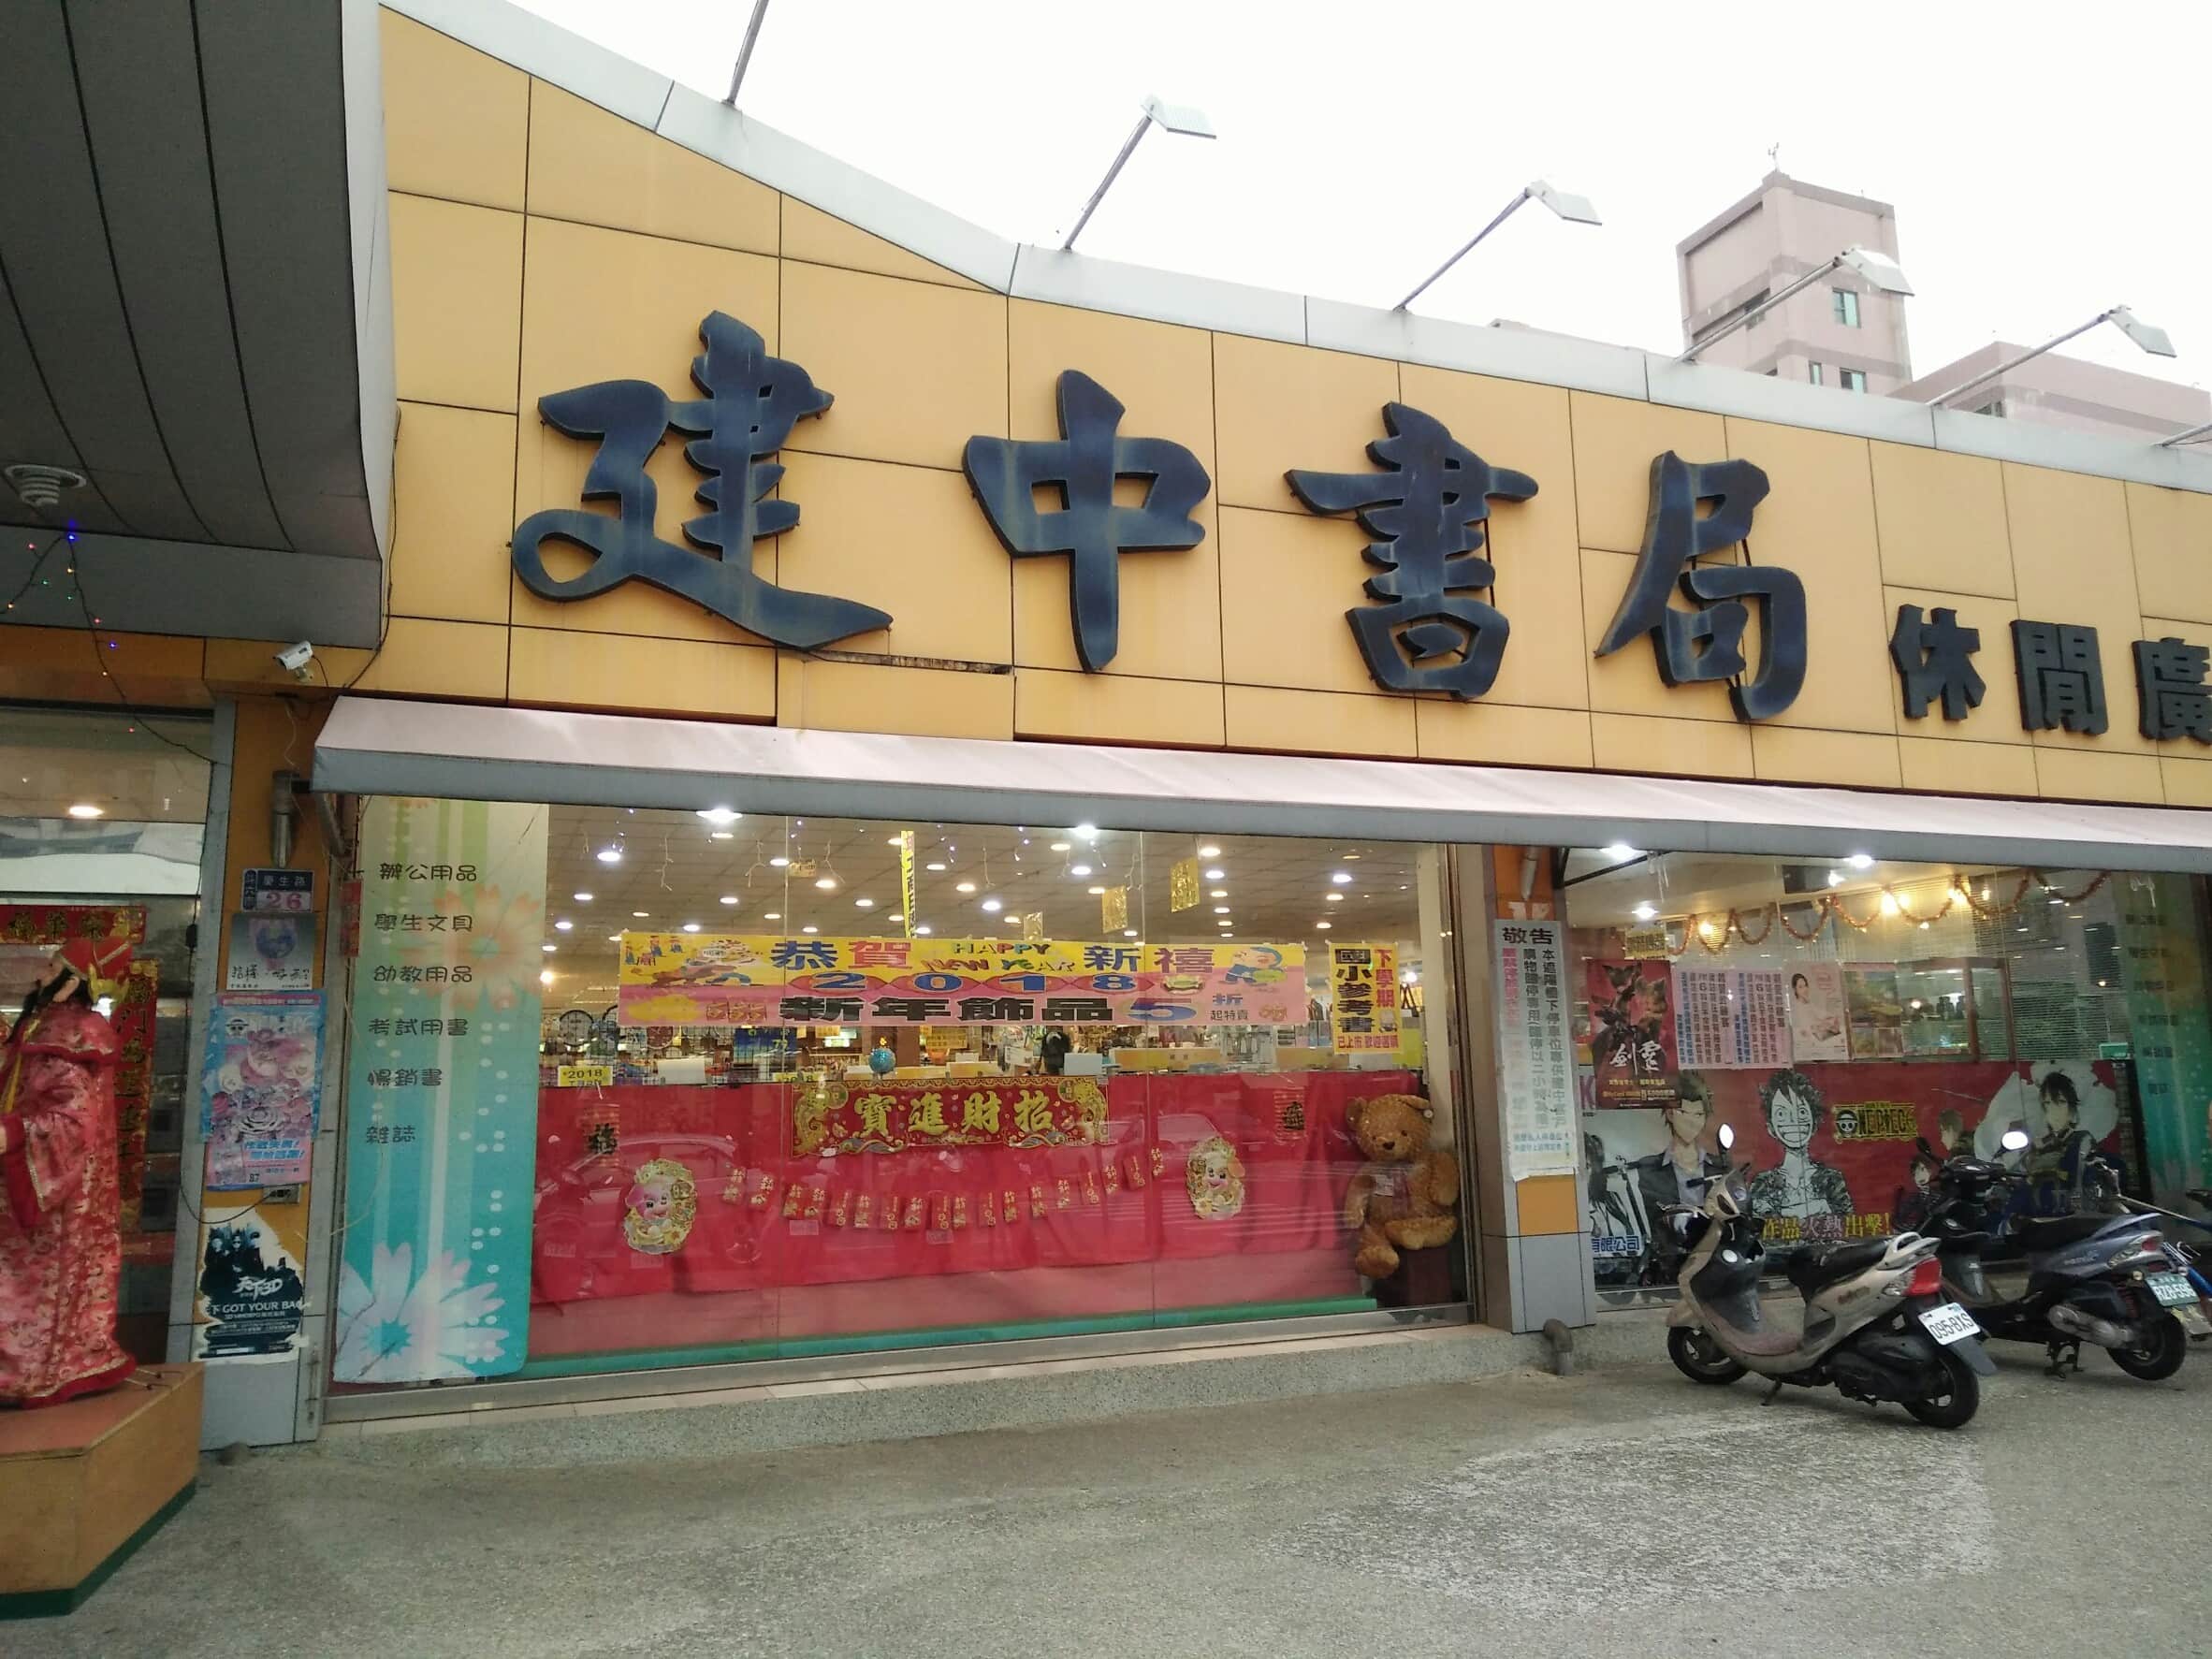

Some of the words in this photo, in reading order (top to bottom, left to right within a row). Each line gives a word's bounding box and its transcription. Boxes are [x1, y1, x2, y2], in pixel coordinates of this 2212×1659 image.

[511, 310, 1807, 722] 建中書局
[379, 863, 477, 881] 辦公用品
[266, 893, 302, 910] 26
[374, 913, 473, 932] 學生文具
[1502, 927, 1554, 945] 敬告
[770, 940, 913, 970] 恭賀
[953, 942, 1050, 954] HAPPY
[921, 958, 990, 971] NEW
[1001, 958, 1076, 971] YEAR
[1084, 945, 1215, 974] 新禧
[373, 965, 473, 983] 幼教用品
[810, 971, 1137, 993] 2018
[1374, 948, 1395, 1008] 下學期
[1334, 948, 1375, 1033] 國小參考書
[779, 997, 1113, 1023] 新年飾品
[368, 1018, 469, 1036] 考試用書
[569, 1070, 603, 1079] 2018
[366, 1126, 416, 1143] 雜誌
[223, 1303, 245, 1313] GOT
[247, 1301, 279, 1312] YOUR
[1928, 1313, 1974, 1339] 095-BXS
